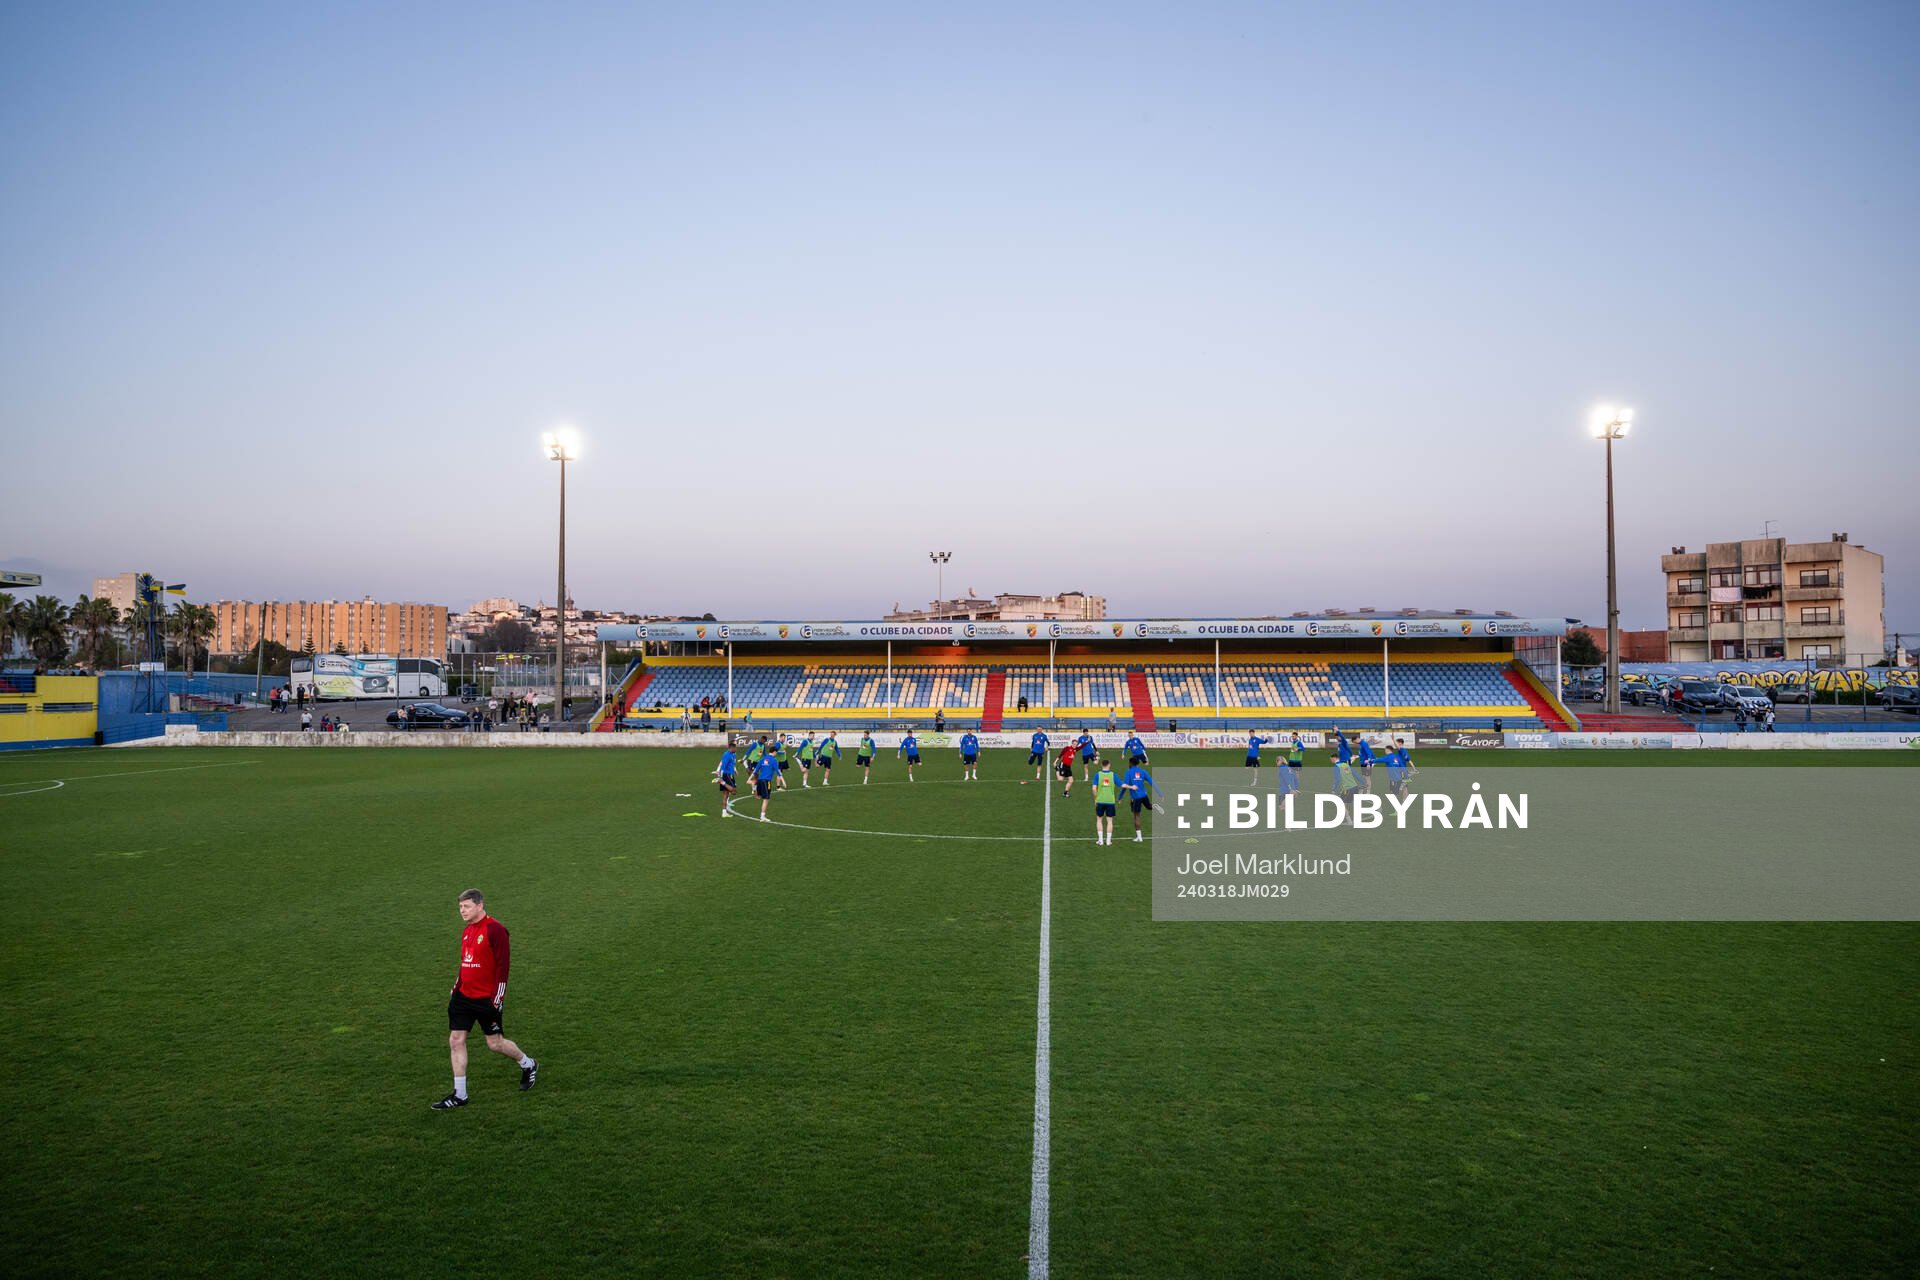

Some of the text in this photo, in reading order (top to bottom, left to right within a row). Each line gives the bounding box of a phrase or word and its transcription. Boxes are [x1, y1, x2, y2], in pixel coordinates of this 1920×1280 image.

[861, 626, 953, 635] O CLUBE DA CIDADE
[1198, 625, 1295, 634] O CLUBE DA CIDADE
[1716, 669, 1881, 693] GONDOMAR
[1461, 739, 1500, 747] PLAYOFF
